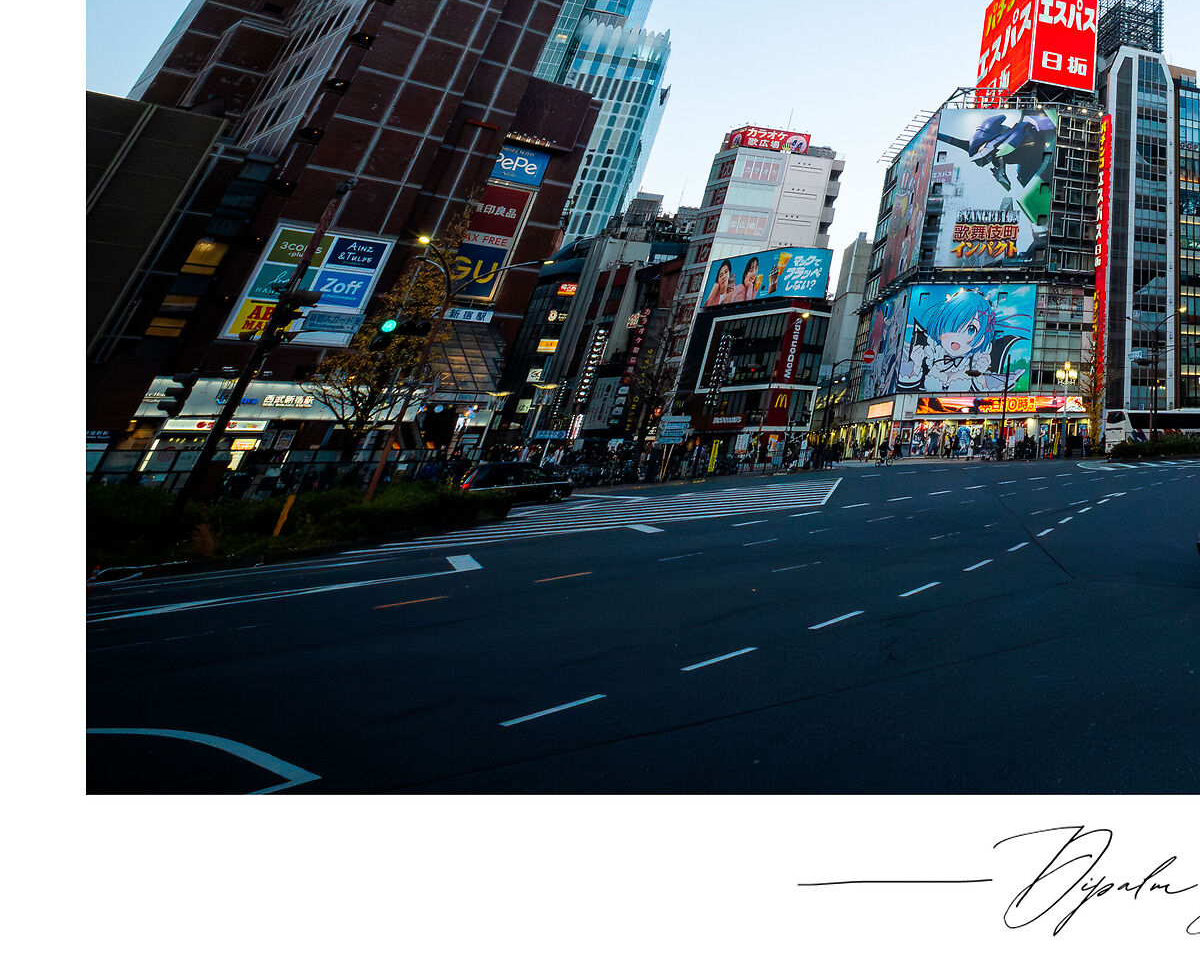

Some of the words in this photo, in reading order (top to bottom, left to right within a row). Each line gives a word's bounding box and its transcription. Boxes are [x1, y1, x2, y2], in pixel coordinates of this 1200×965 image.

[977, 0, 1033, 84] エスパス
[1041, 50, 1088, 76] 日拓
[748, 128, 789, 141] カラオケ
[748, 138, 781, 150] 歌広場
[1098, 120, 1107, 169] パチンコ
[1095, 171, 1105, 242] エスパス
[482, 235, 509, 247] FREE
[953, 224, 1020, 242] 歌舞伎町
[950, 240, 1018, 258] インパクト
[450, 255, 499, 285] GU
[786, 267, 823, 282] フラッペ
[319, 277, 364, 296] Zoff
